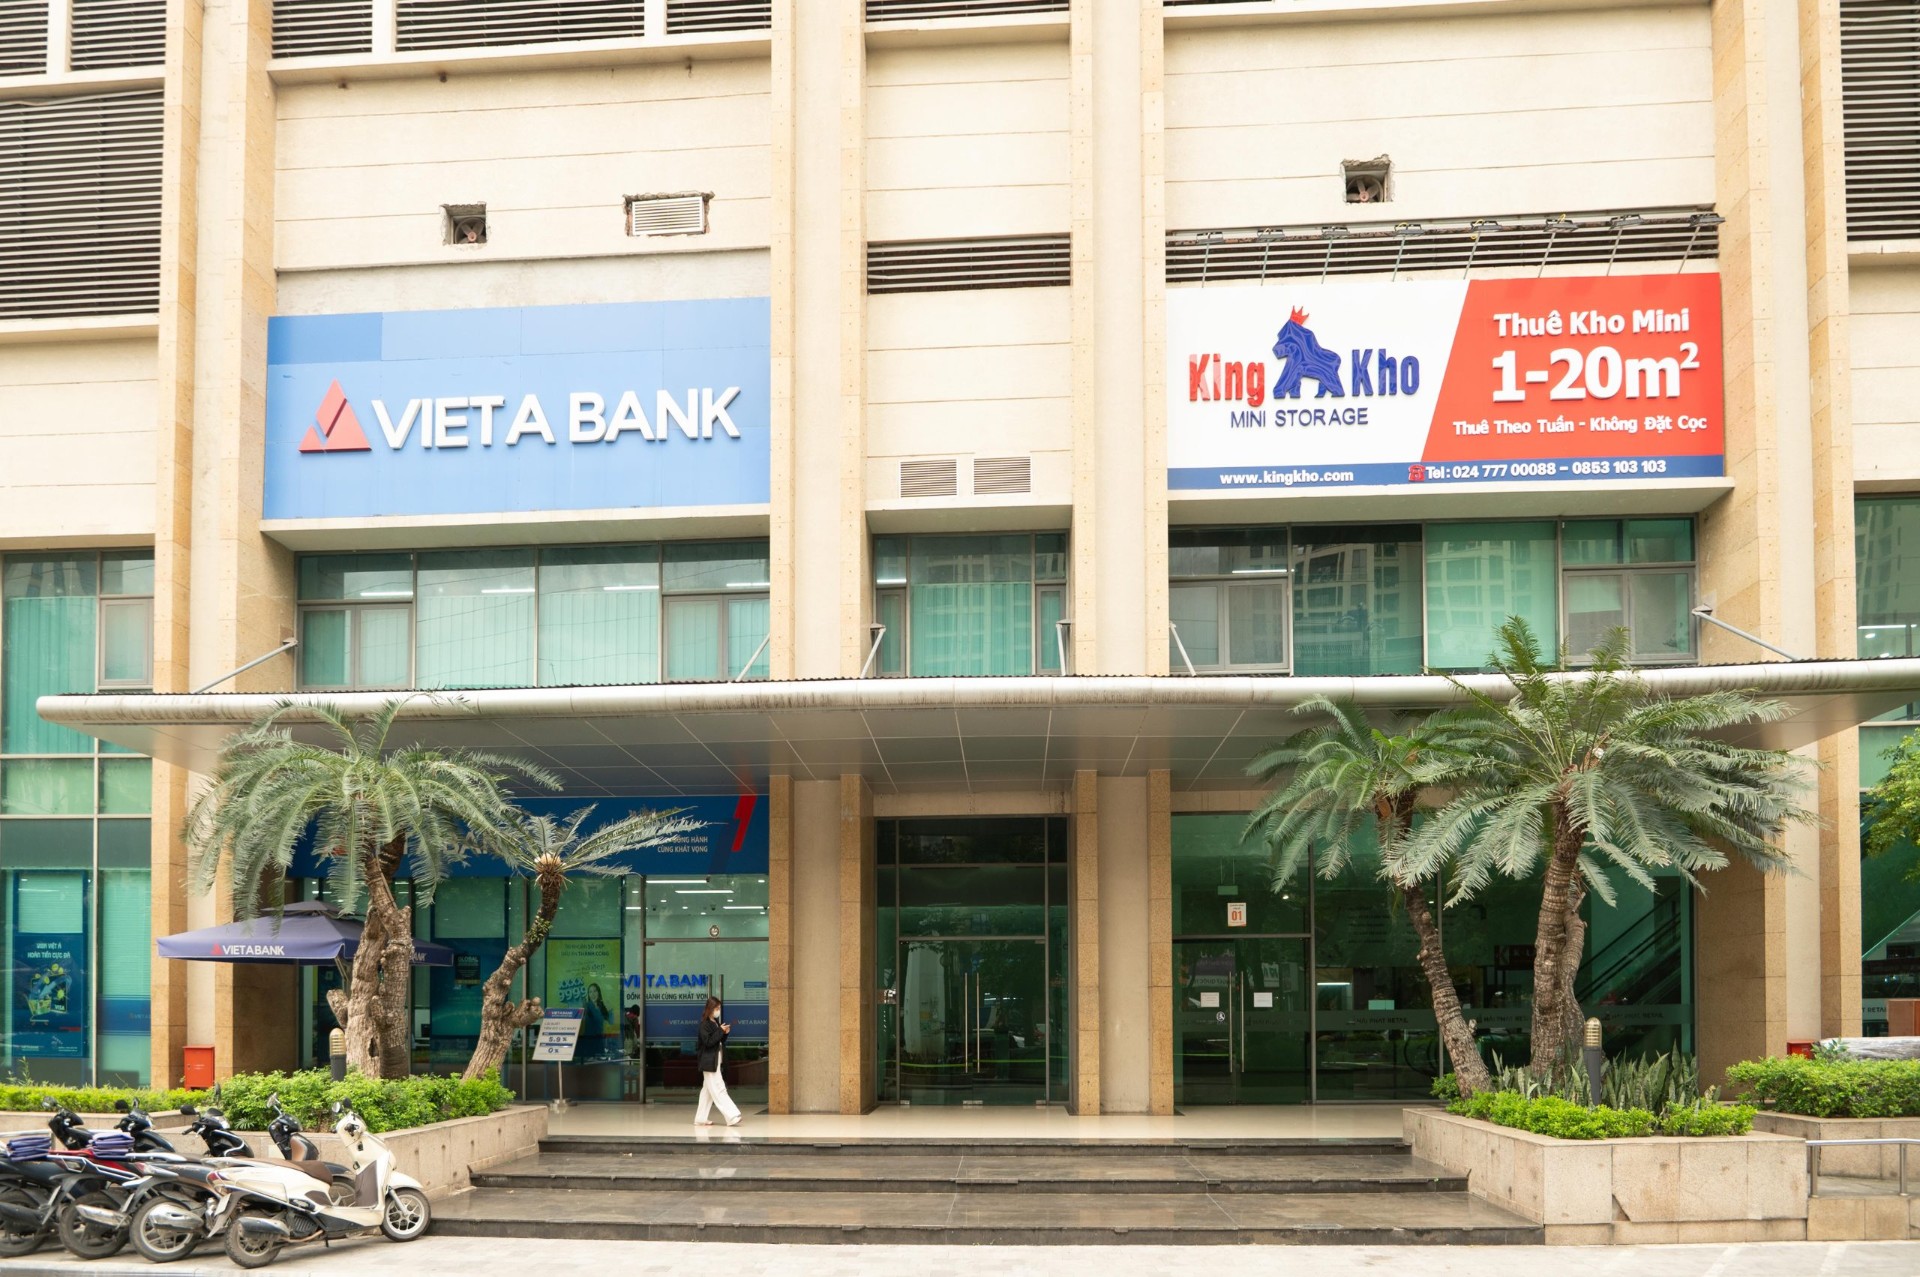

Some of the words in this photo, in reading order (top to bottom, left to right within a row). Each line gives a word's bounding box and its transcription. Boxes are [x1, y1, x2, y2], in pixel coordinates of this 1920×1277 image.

[1493, 310, 1563, 337] Thuê
[1569, 310, 1626, 335] Kho
[1632, 308, 1690, 333] Mini
[1188, 353, 1265, 407] King
[1352, 348, 1420, 397] Kho
[1230, 410, 1267, 429] MINI
[1275, 407, 1369, 427] STORAGE
[1453, 419, 1490, 436] Thuê
[1494, 419, 1532, 434] Theo
[1590, 416, 1638, 433] Không
[1644, 415, 1673, 433] Đặt
[1677, 415, 1708, 433] Cọc
[1220, 470, 1354, 486] www.kingkho.com
[1452, 464, 1480, 479] 024
[1482, 464, 1508, 477] 777
[1510, 461, 1557, 477] 00088
[1572, 460, 1610, 475] 0853
[1613, 459, 1639, 474] 103
[1641, 459, 1667, 473] 103
[1231, 910, 1242, 921] 01
